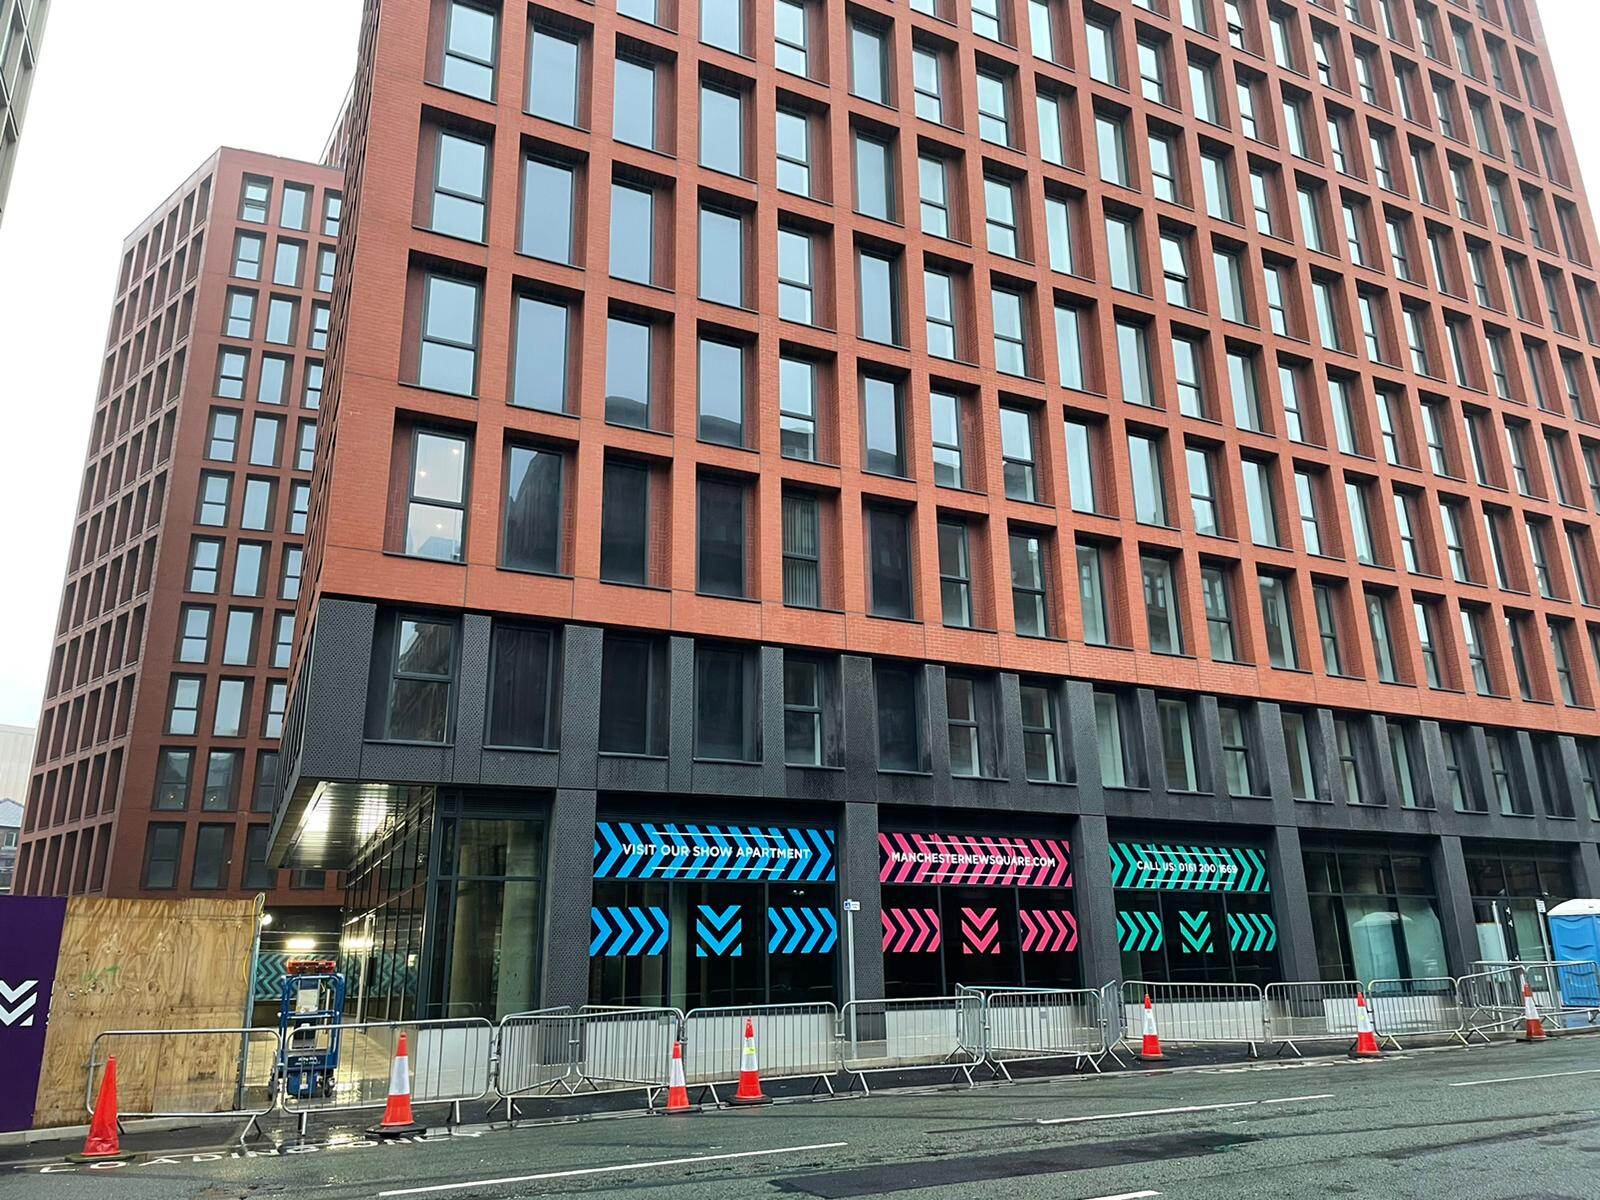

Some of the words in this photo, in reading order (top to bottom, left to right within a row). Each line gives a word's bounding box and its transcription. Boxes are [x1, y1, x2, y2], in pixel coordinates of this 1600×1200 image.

[622, 843, 657, 855] VISIT
[661, 844, 690, 857] OUR
[693, 845, 733, 858] SHOW
[736, 846, 811, 860] APARTMENT
[891, 852, 1056, 867] MANCHESTERNEWSQUARE.COM
[1136, 860, 1160, 871] CALL
[1179, 862, 1197, 872] 0161
[1199, 863, 1216, 873] 200
[40, 1146, 319, 1173] LOADING
